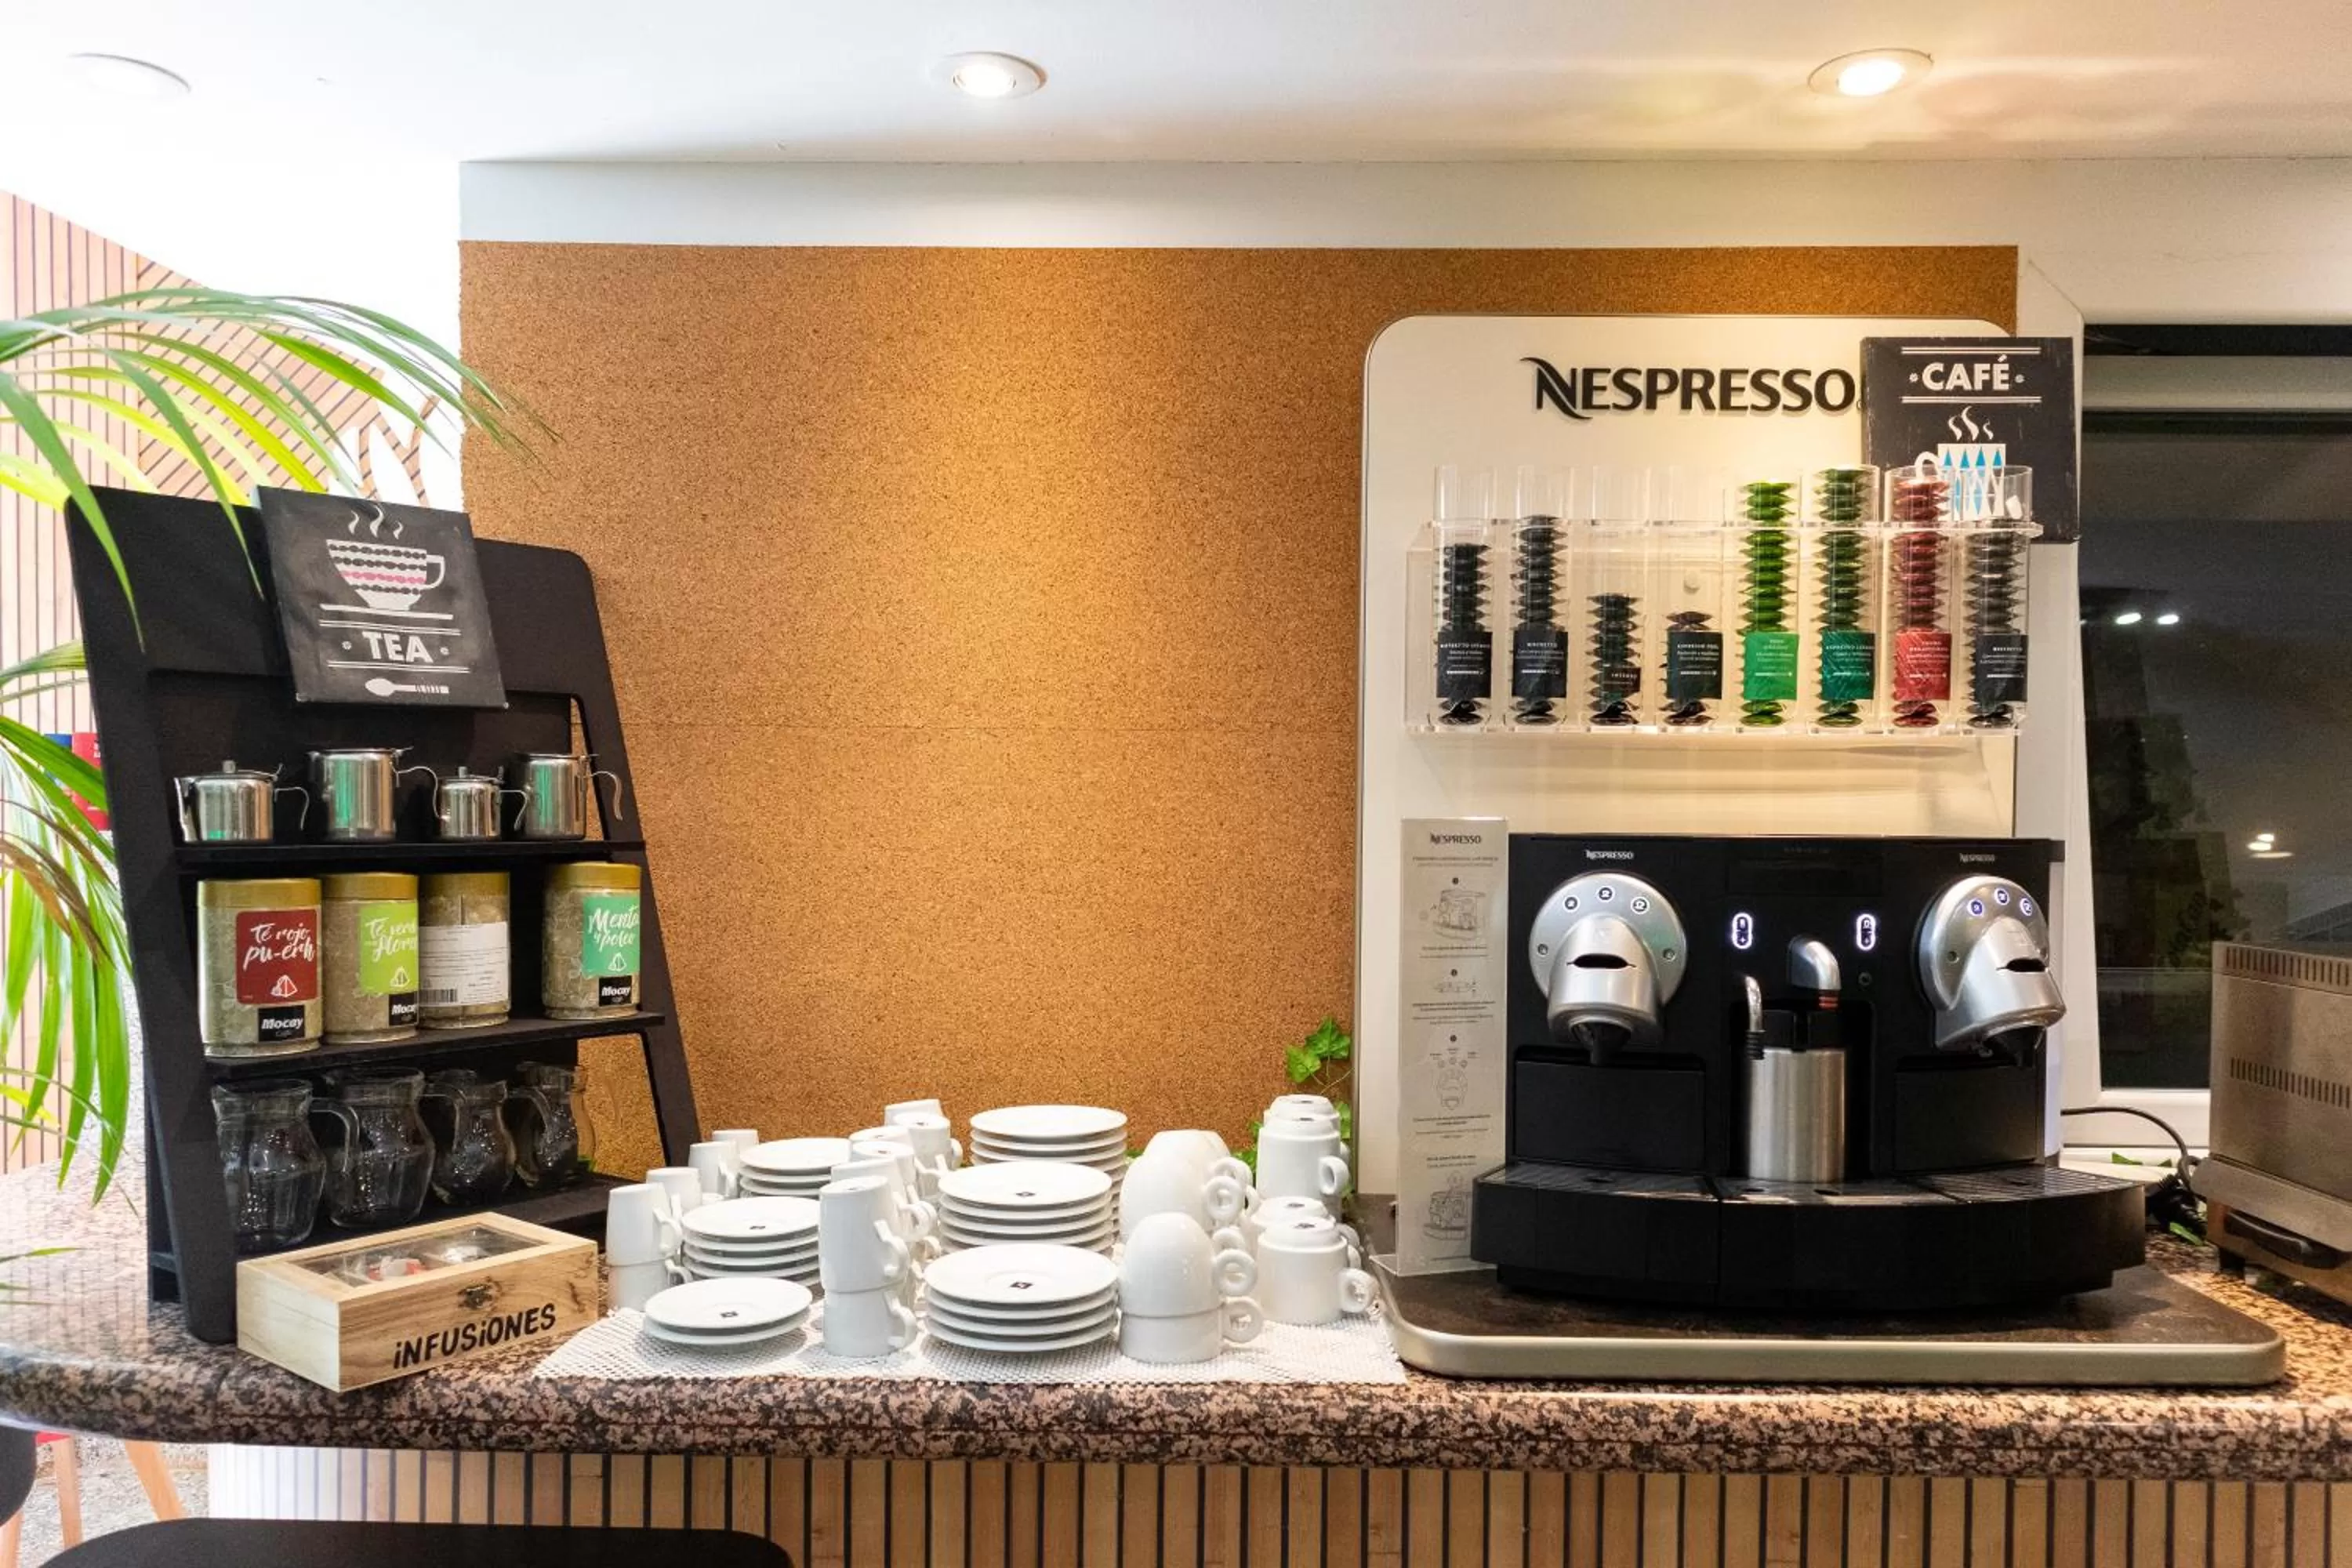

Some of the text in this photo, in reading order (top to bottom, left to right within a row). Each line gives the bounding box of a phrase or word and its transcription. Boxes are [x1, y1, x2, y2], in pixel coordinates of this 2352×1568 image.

[1922, 354, 2010, 391] CAFÉ
[1520, 357, 1856, 419] NESPRESSO
[362, 630, 434, 663] TEA
[1430, 833, 1482, 845] NESPRESSO
[1585, 849, 1635, 860] NESPRESSO
[275, 923, 311, 946] rojo
[601, 985, 631, 996] Mocay
[261, 1017, 303, 1029] Mocay
